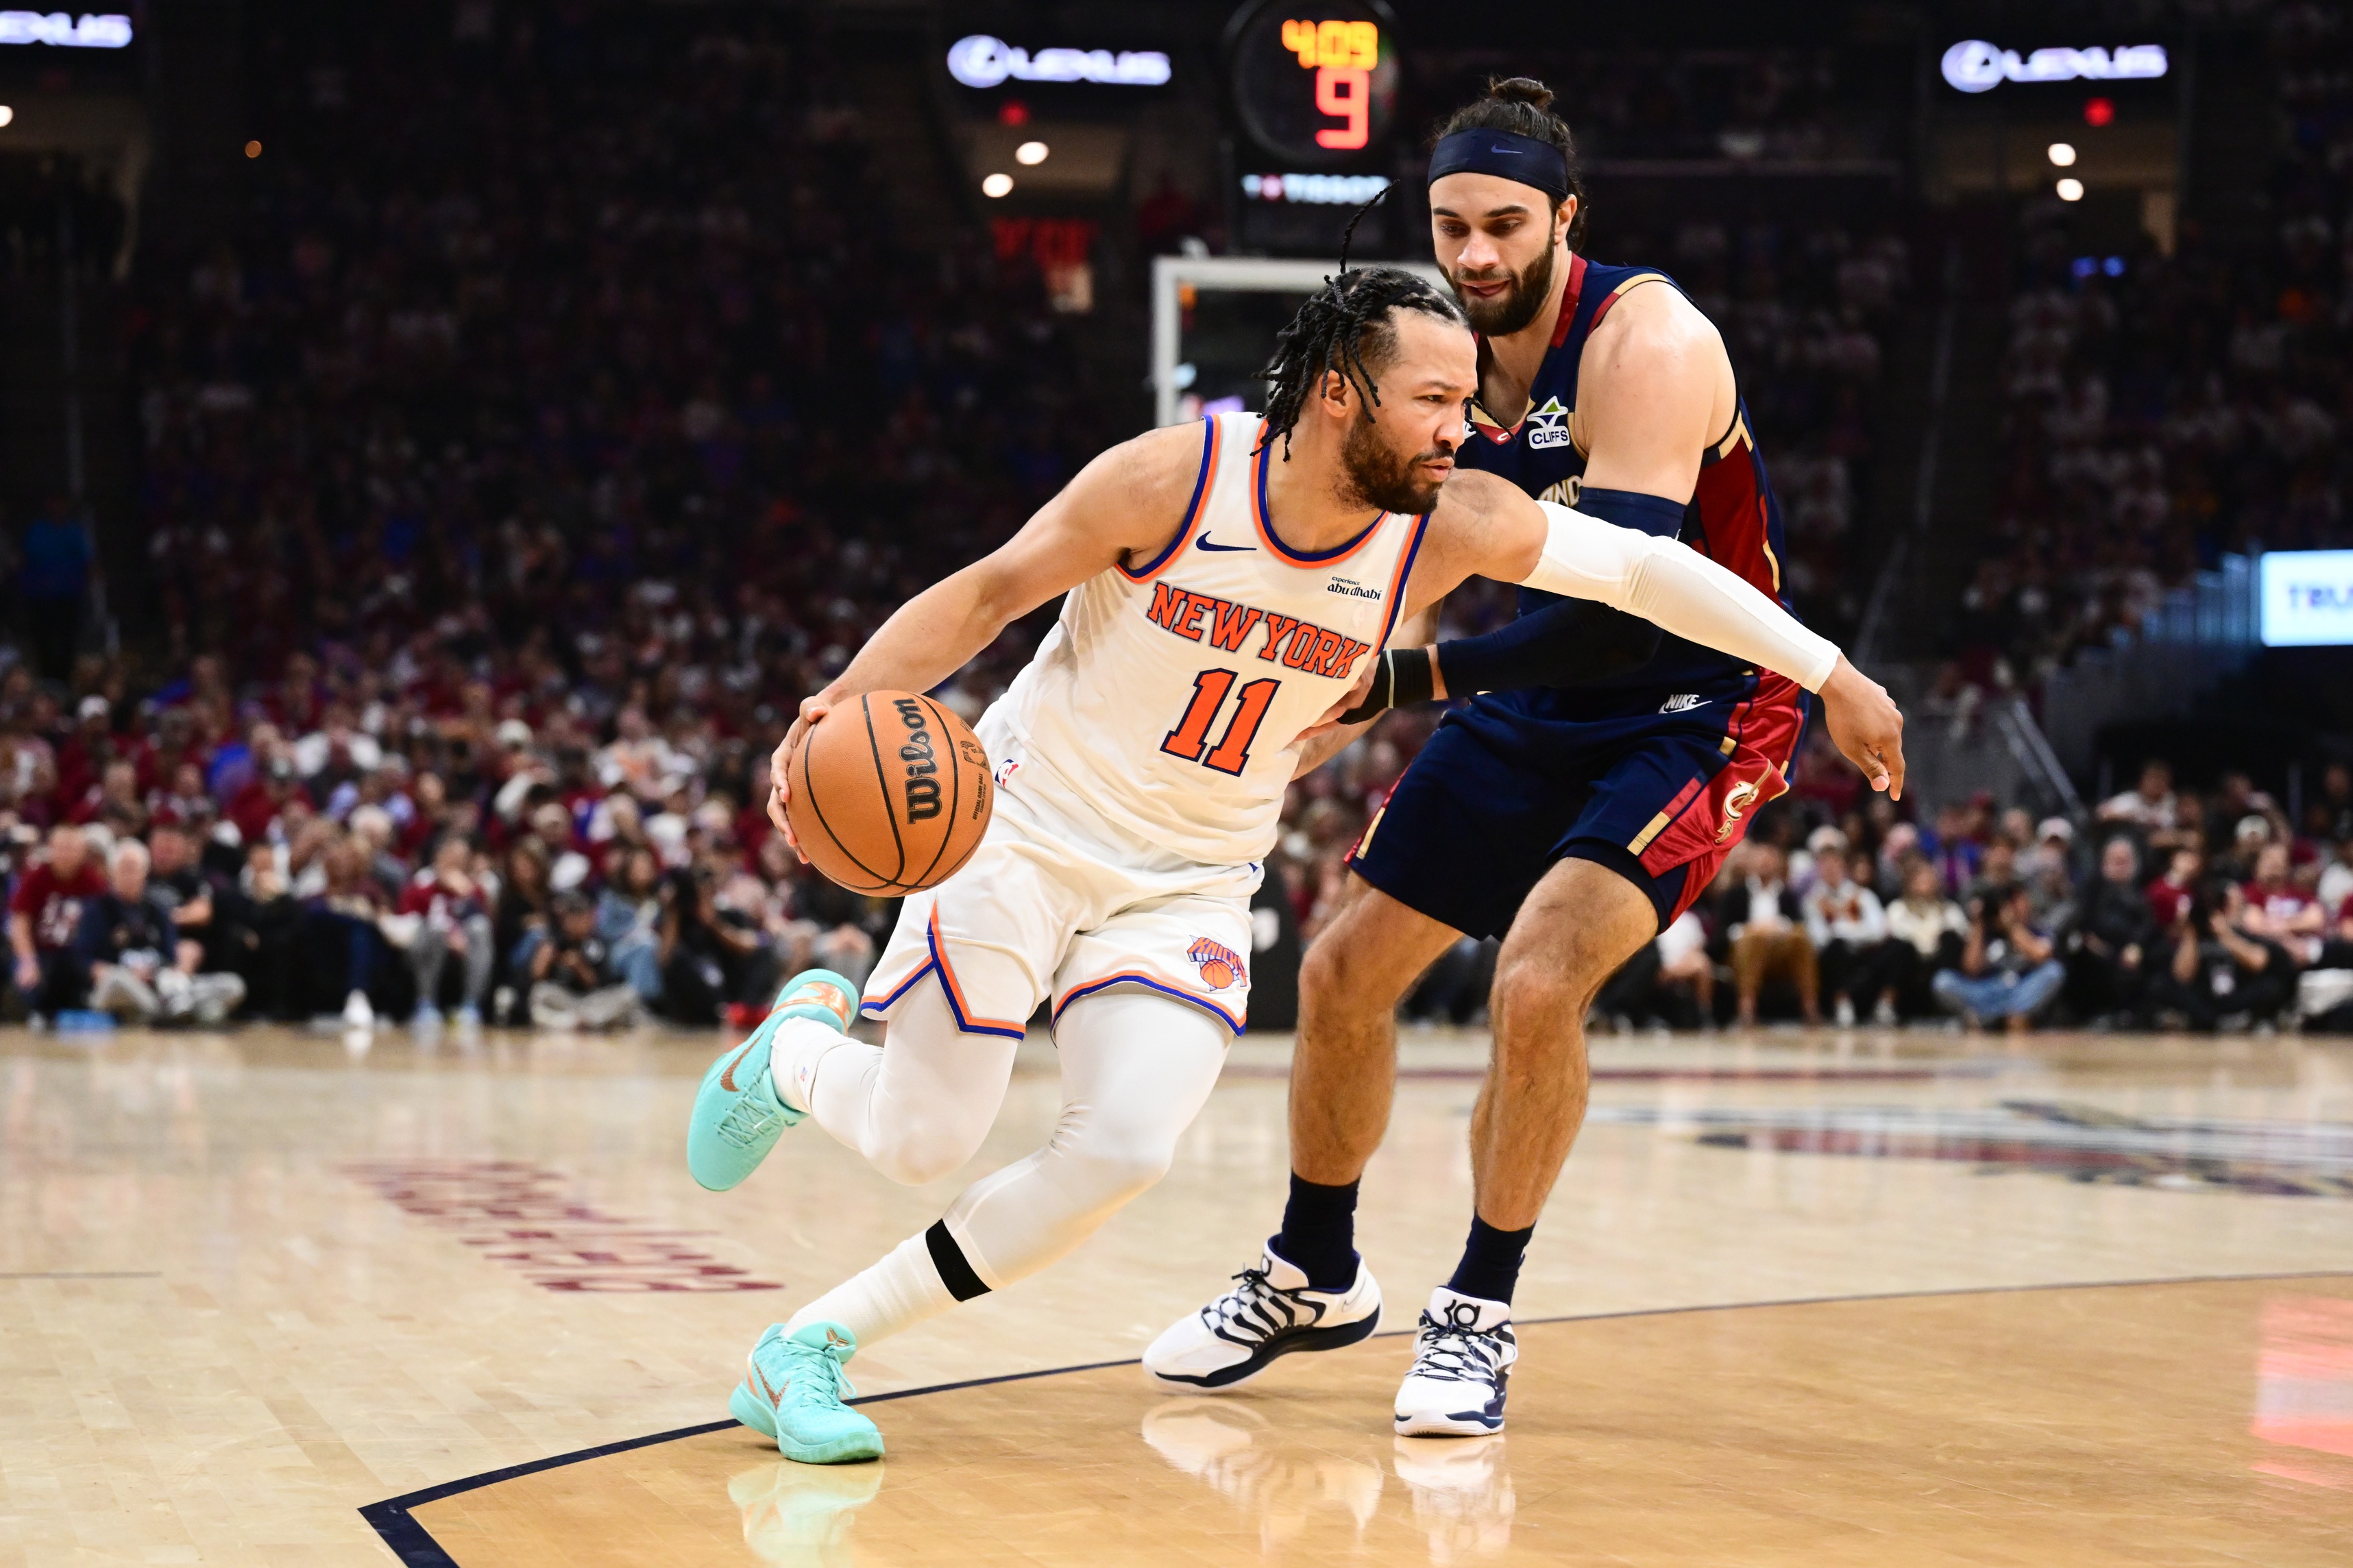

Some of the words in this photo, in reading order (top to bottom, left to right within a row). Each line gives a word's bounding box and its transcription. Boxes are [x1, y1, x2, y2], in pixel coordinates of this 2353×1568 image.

[1315, 67, 1369, 149] 9
[1531, 430, 1569, 445] CLIFFS
[1327, 583, 1350, 595] abu
[1350, 587, 1382, 600] dhabi
[1332, 576, 1361, 585] experience
[1147, 580, 1262, 653] NEW
[1256, 611, 1373, 680] YORK
[1159, 667, 1282, 778] 11
[1665, 694, 1700, 709] NIKE
[892, 698, 943, 825] Wilson
[1186, 936, 1247, 987] KNICKS
